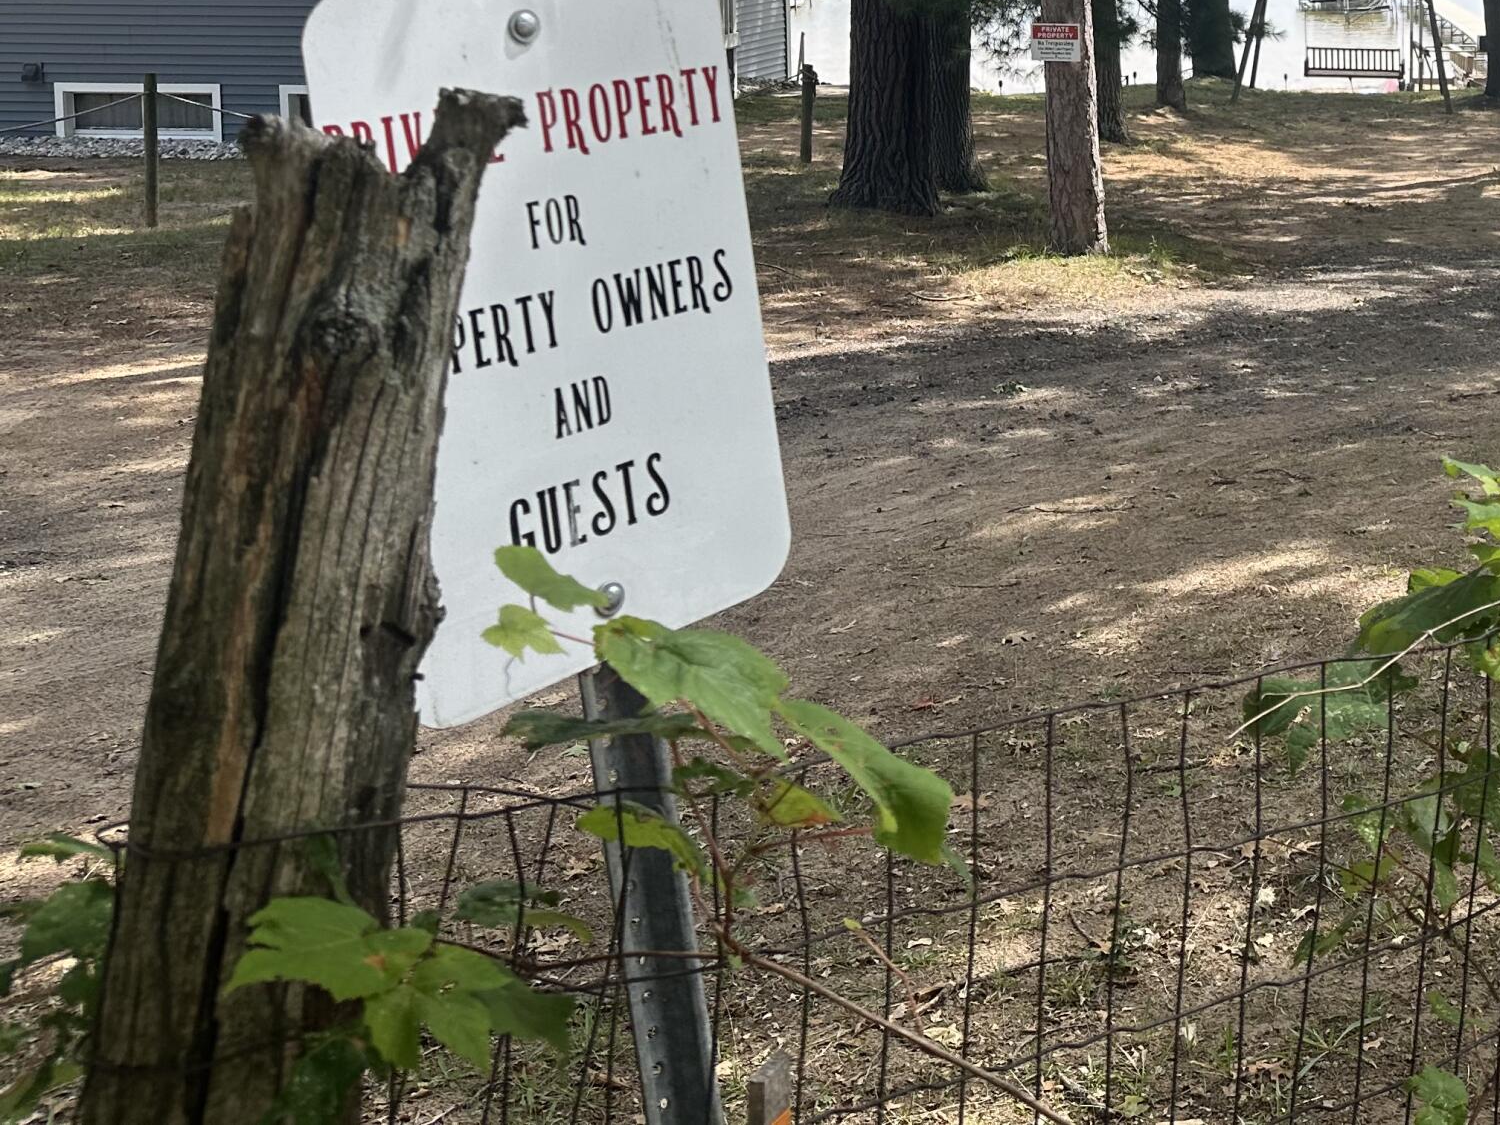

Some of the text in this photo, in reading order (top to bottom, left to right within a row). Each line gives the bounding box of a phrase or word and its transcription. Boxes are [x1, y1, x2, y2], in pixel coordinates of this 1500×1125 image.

[535, 66, 721, 155] PROPERTY
[526, 195, 586, 250] FOR
[450, 249, 732, 374] PERTY OWNERS
[554, 375, 612, 439] AND
[509, 452, 670, 555] GUESTS
